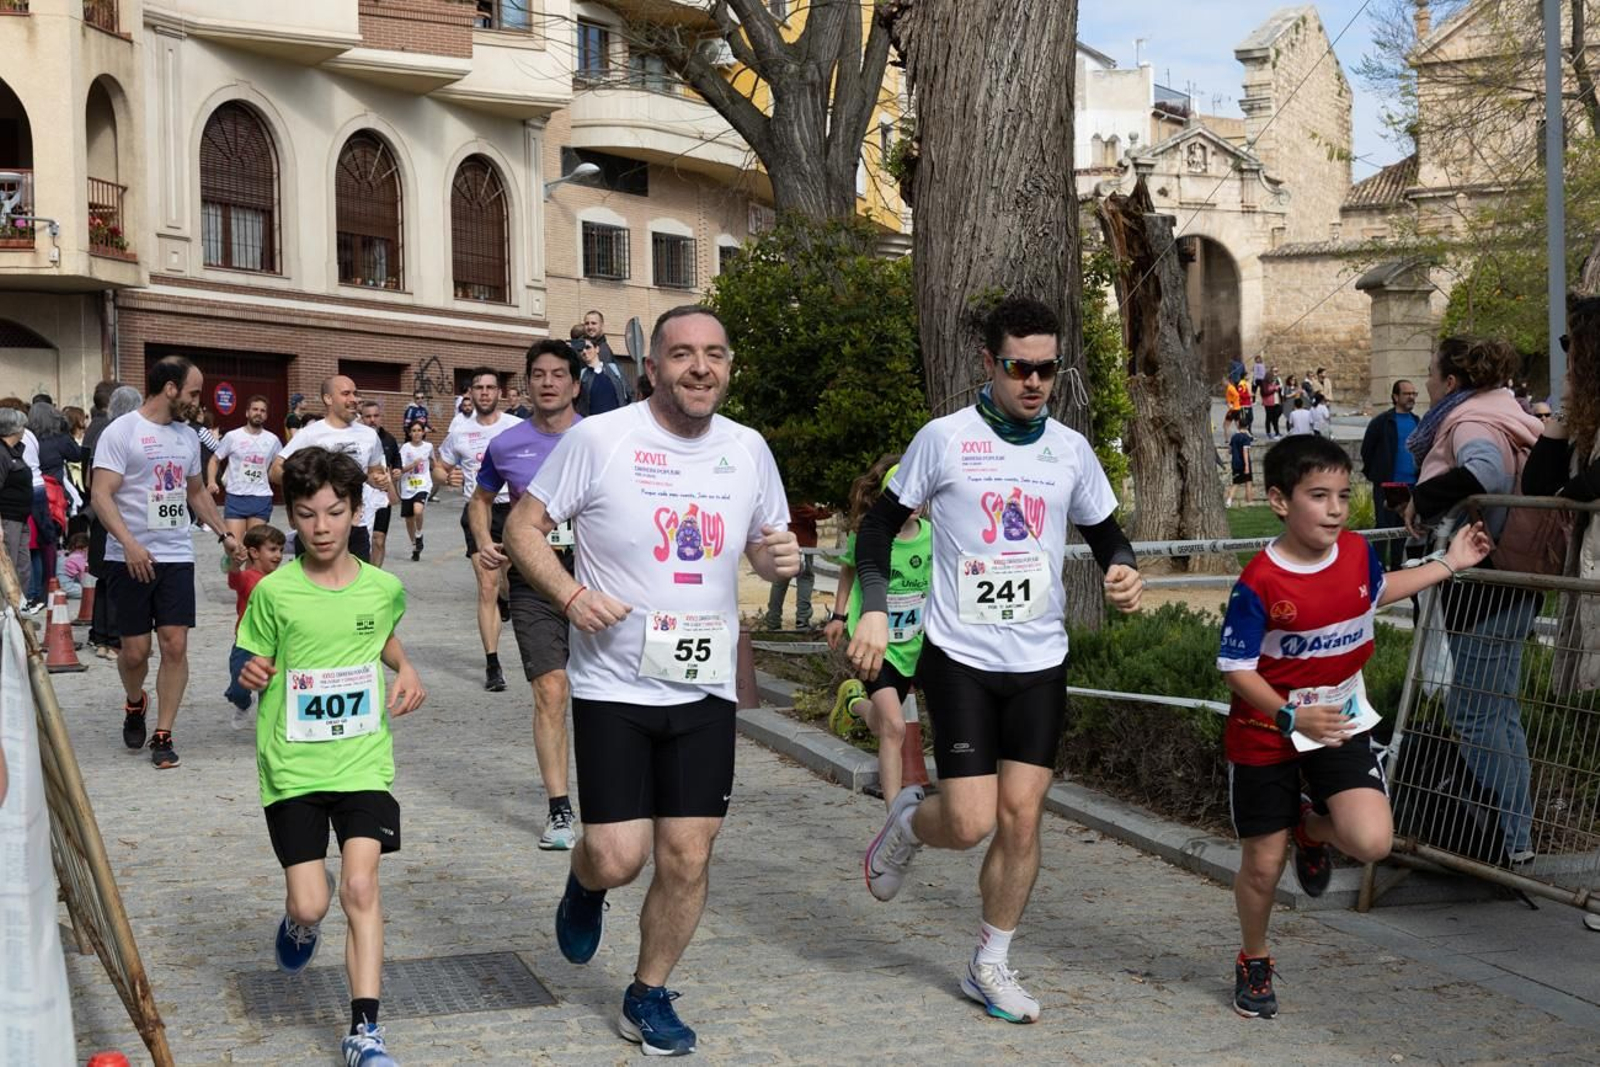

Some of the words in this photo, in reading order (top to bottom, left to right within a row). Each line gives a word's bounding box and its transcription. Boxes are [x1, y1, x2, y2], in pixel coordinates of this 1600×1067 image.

[961, 441, 992, 453] XXVII
[634, 450, 667, 466] XXVII
[244, 470, 262, 479] 442
[159, 504, 184, 518] 866
[981, 491, 1045, 545] SALUD
[653, 506, 724, 562] SALUD
[1178, 544, 1204, 553] DEPORTES
[976, 579, 1030, 603] 241
[674, 638, 711, 662] 55
[305, 690, 364, 719] 407
